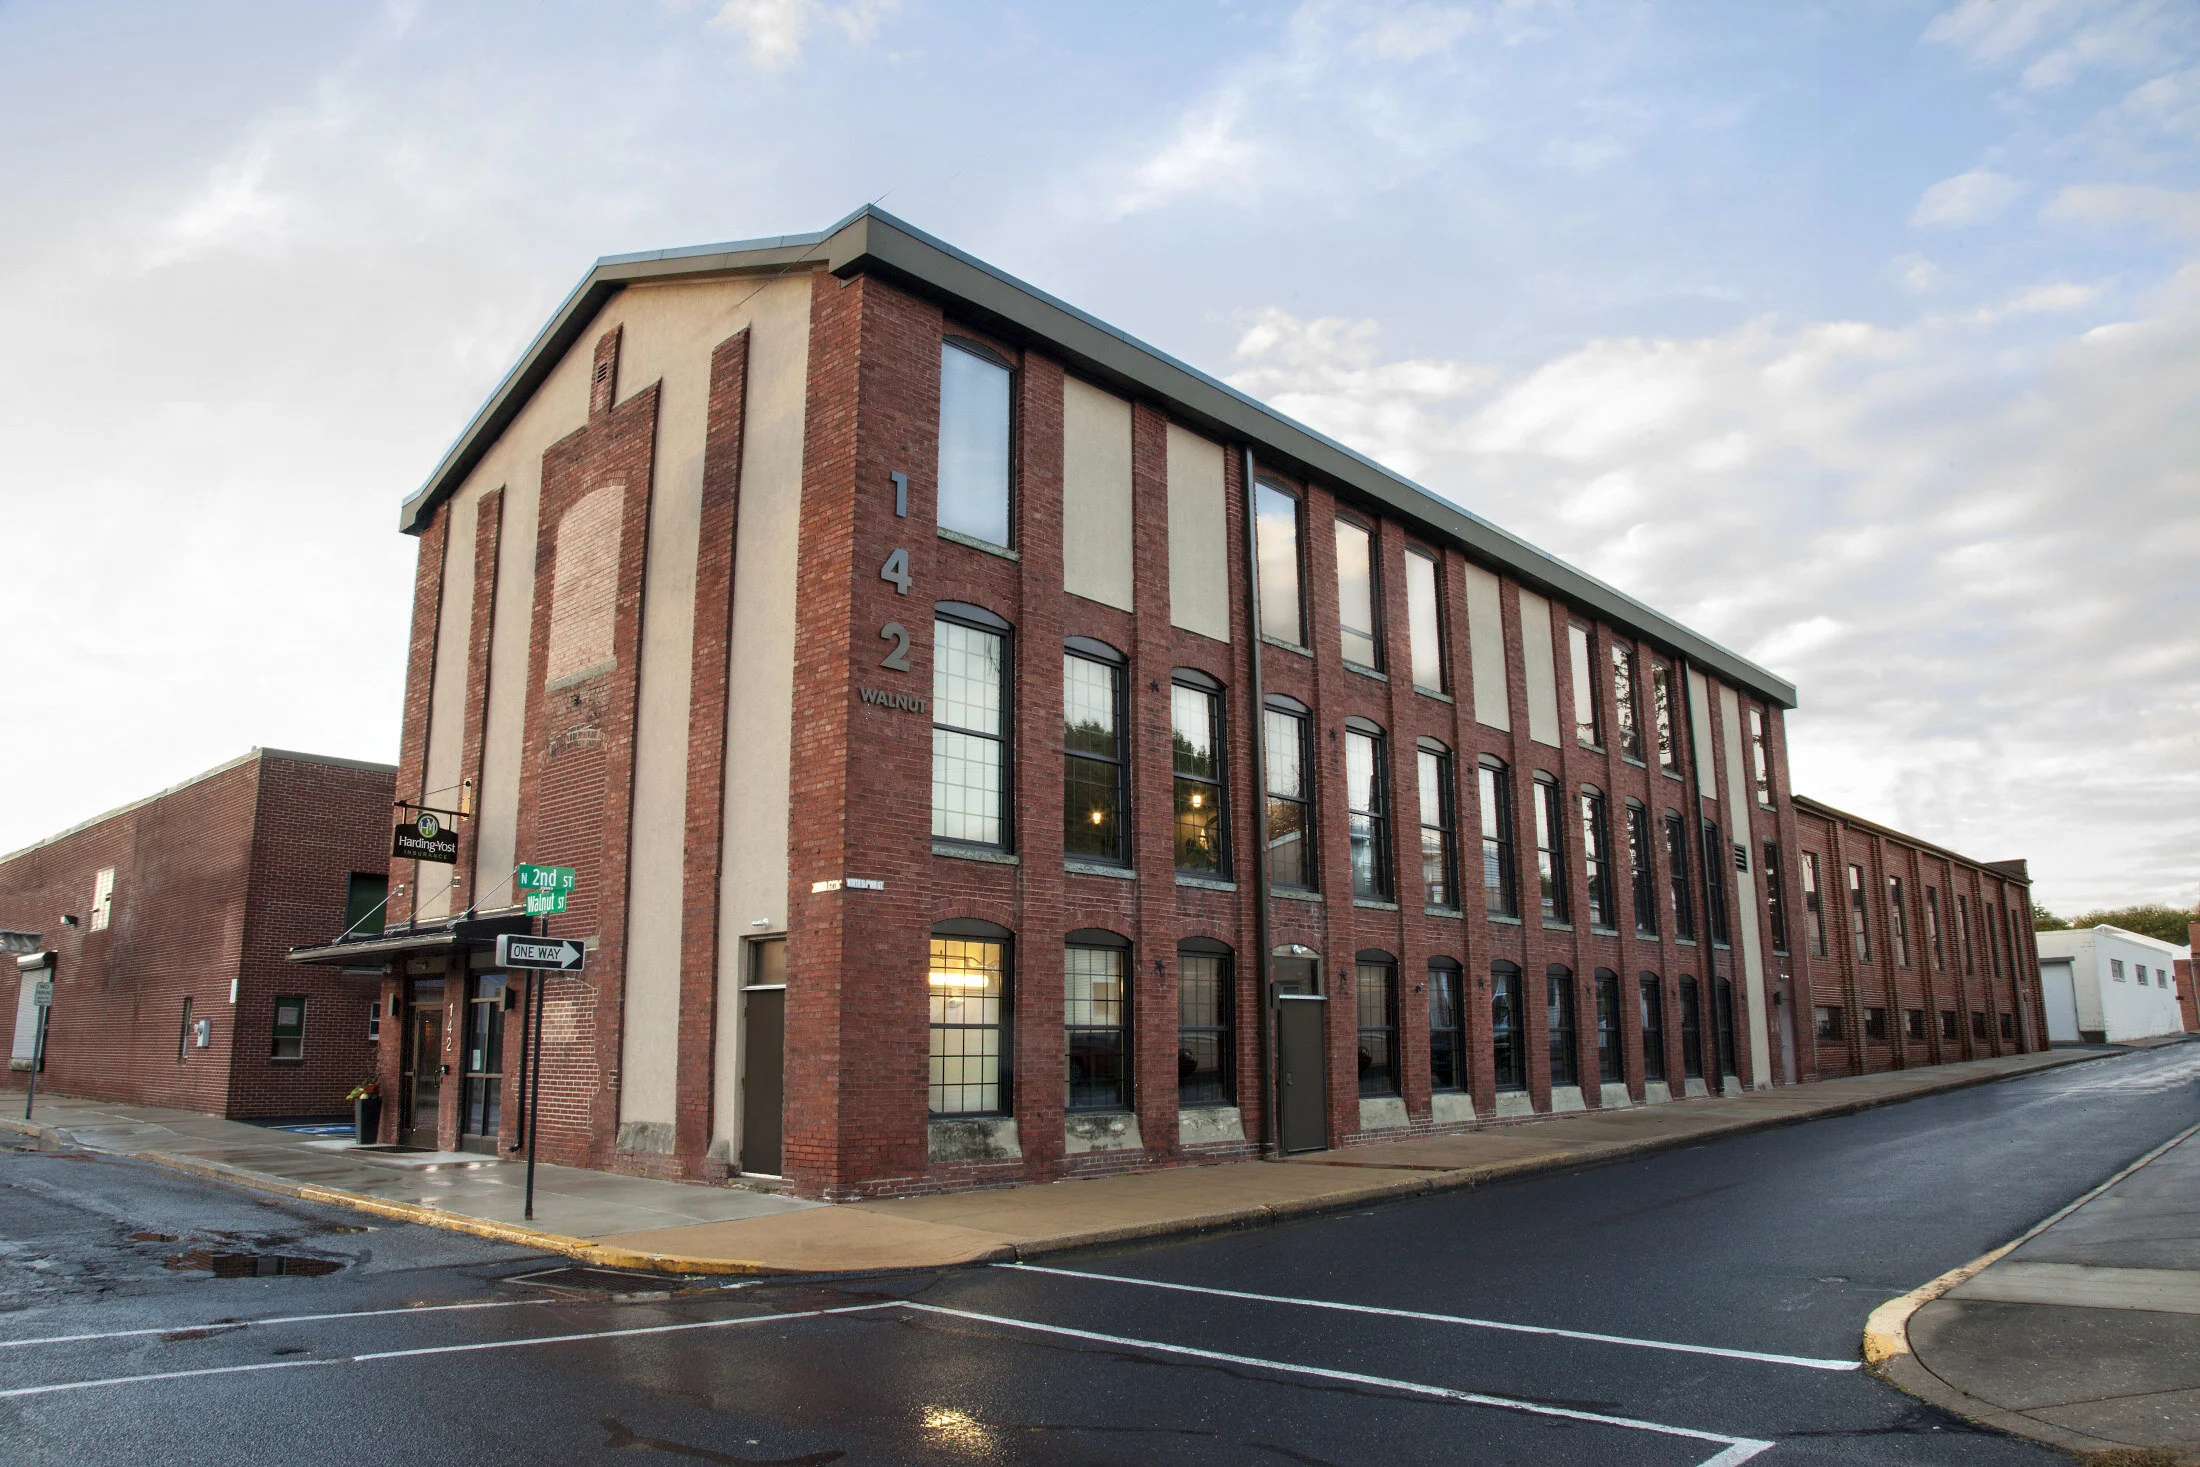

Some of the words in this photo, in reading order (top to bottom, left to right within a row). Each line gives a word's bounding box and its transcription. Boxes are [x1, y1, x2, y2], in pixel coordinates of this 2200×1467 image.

[860, 686, 926, 714] WALNUT
[398, 835, 456, 853] Harding-Yost
[403, 849, 448, 860] INSURANCE
[521, 872, 528, 885] N
[532, 868, 557, 887] 2nd
[562, 875, 573, 888] ST
[527, 893, 555, 913] Walnut
[557, 896, 565, 909] ST
[513, 945, 535, 958] ONE
[538, 947, 561, 960] WAY
